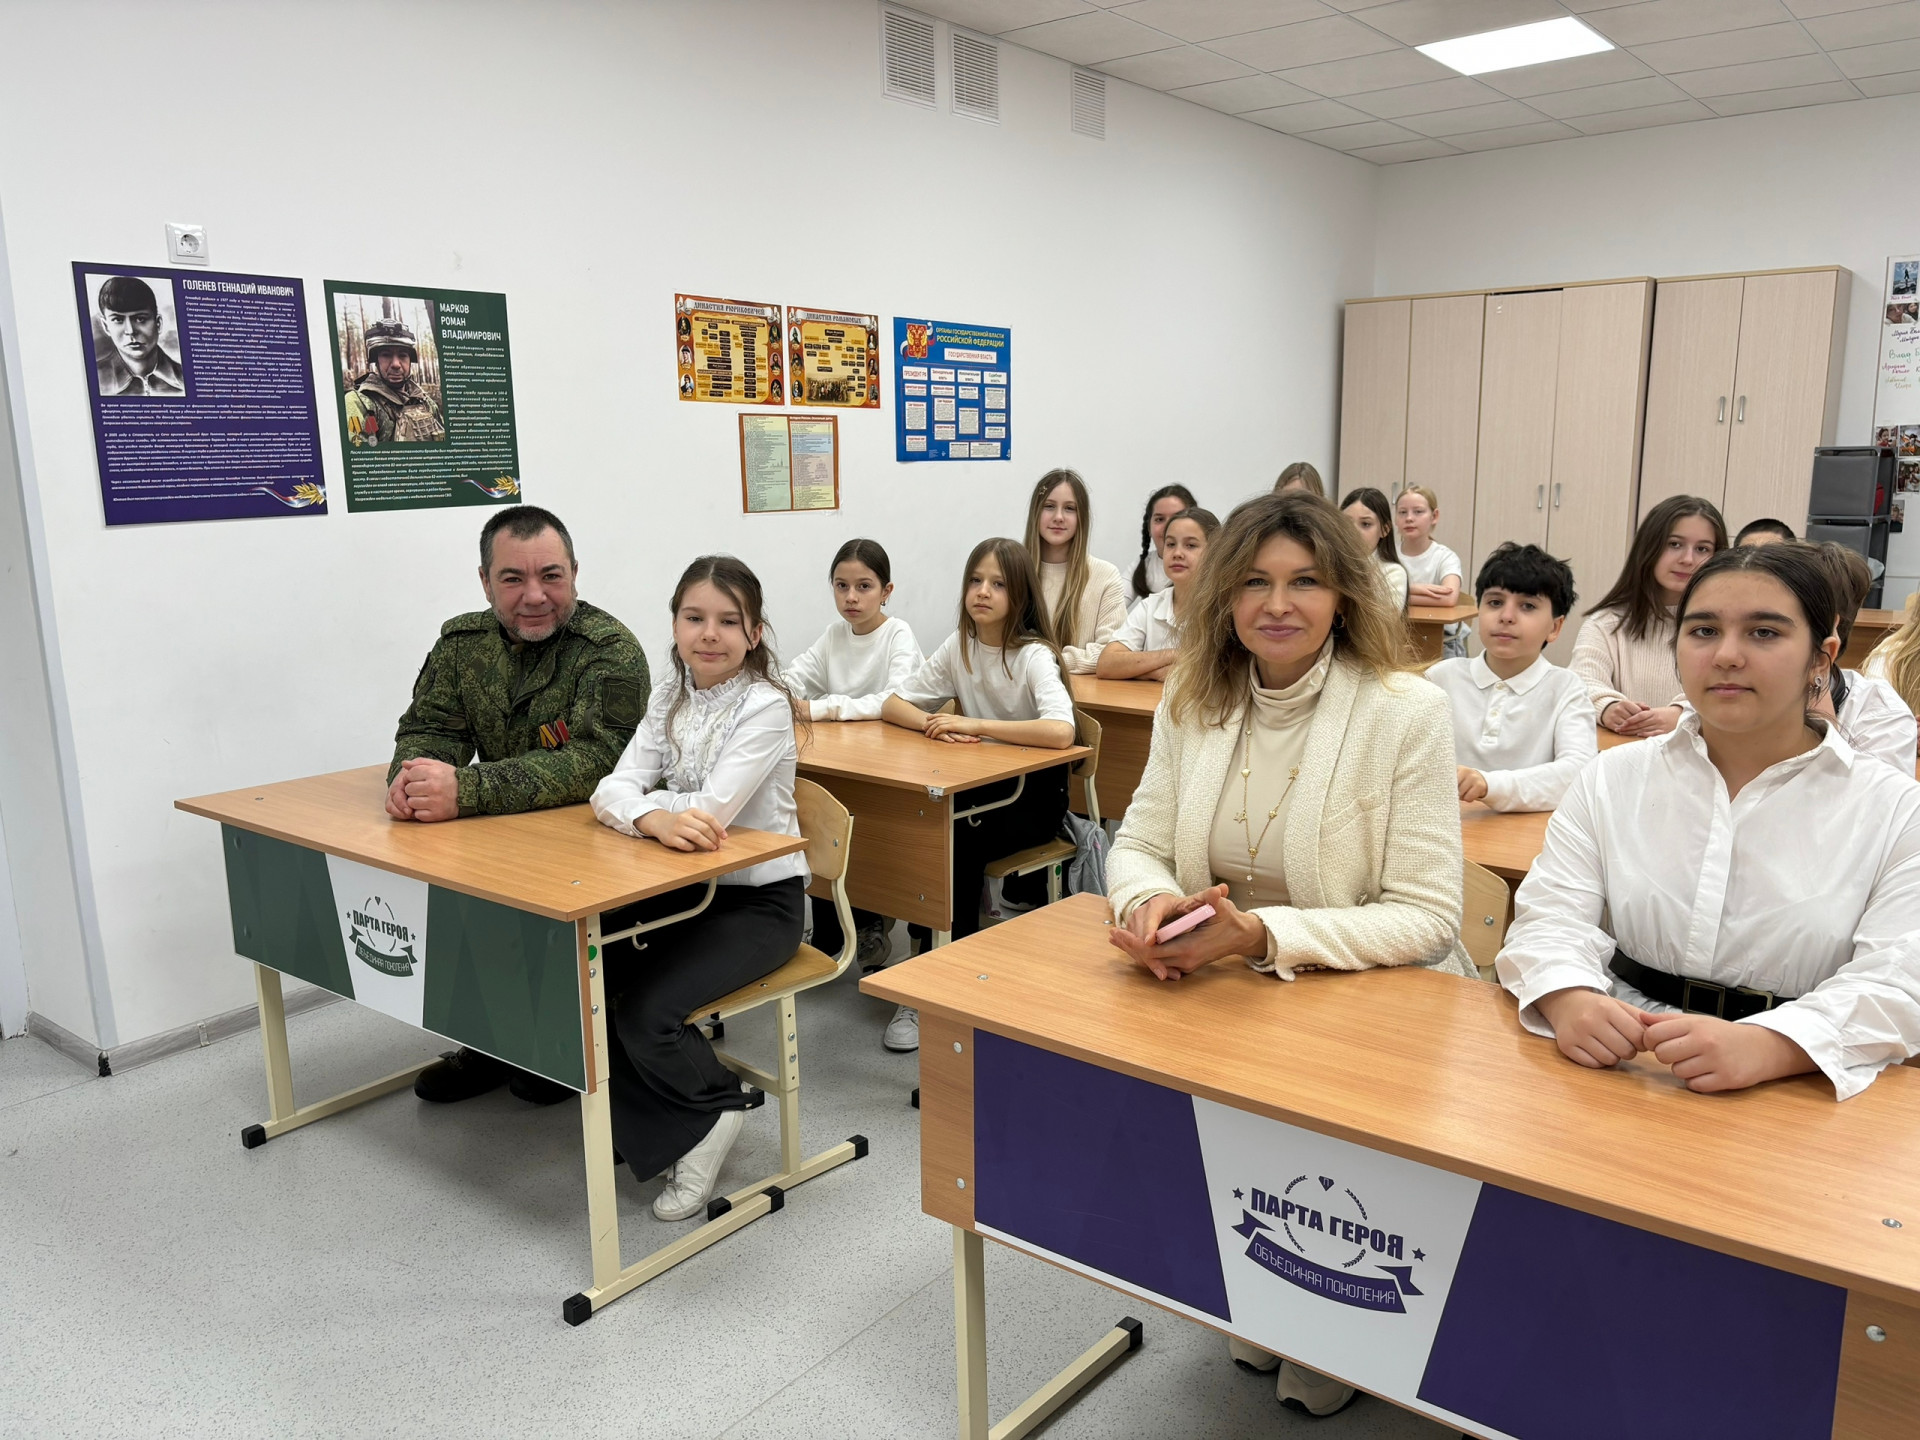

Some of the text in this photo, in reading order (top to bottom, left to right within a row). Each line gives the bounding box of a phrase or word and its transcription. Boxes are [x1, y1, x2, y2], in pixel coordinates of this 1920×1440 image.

[182, 279, 295, 297] ГОЛЕНЕВ ГЕННАДИЙ ИВАНОВИЧ
[439, 302, 470, 314] МАРКОВ
[440, 315, 467, 327] РОМАН
[441, 329, 502, 342] ВЛАДИМИРОВИЧ
[936, 335, 1005, 348] РОССИЙСКОЙ ФЕДЕРАЦИИ
[353, 909, 409, 942] ПАРТА ГЕРОЯ
[1251, 1187, 1404, 1261] ПАРТА ГЕРОЯ
[1325, 1277, 1396, 1304] ПОКОЛЕНИЯ
